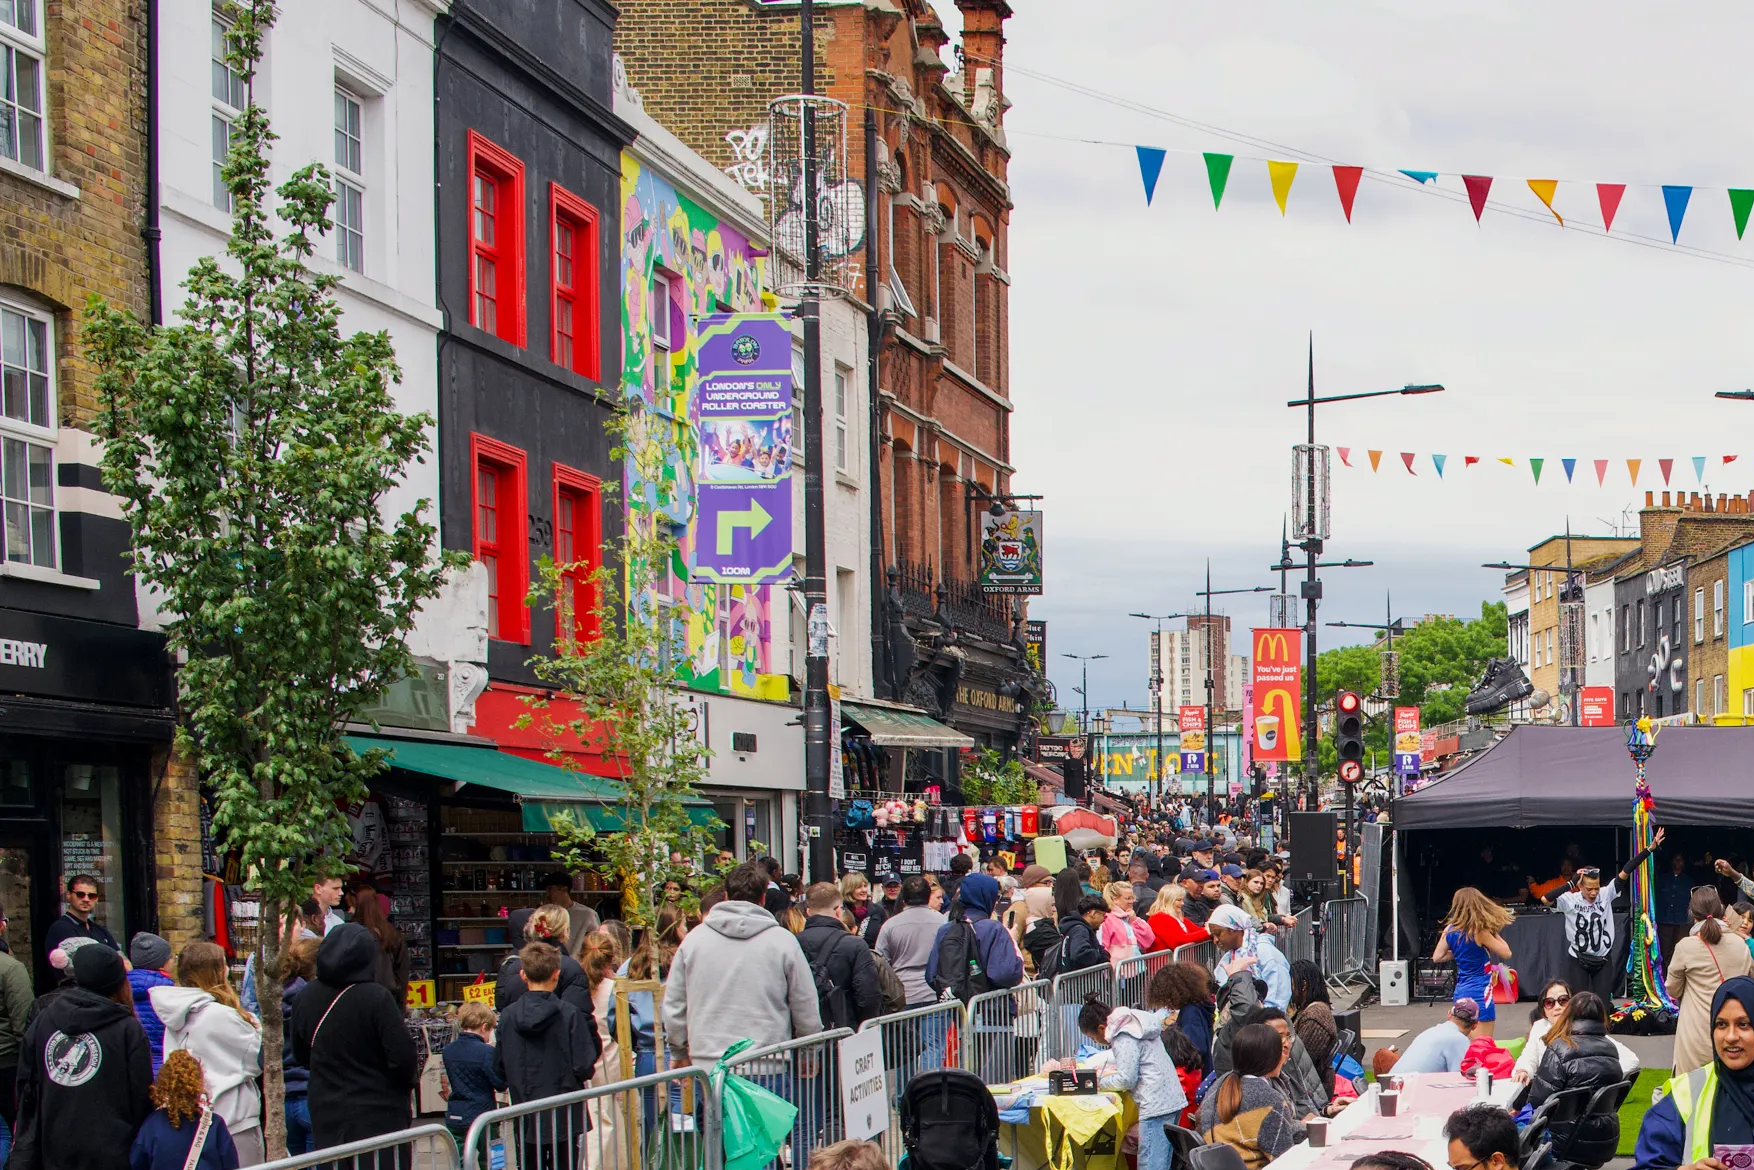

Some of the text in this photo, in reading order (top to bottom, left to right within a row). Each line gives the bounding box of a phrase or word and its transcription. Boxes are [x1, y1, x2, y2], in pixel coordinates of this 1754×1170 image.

[705, 381, 782, 391] LONDON'S ONLY
[705, 391, 780, 401] UNDERGROUND
[701, 401, 787, 411] ROLLER COASTER
[721, 566, 751, 575] 100M
[983, 585, 1040, 593] OXFORD ARMS
[0, 638, 47, 668] ERRY
[1281, 665, 1297, 675] just
[1256, 674, 1284, 683] passed
[955, 686, 1015, 713] THE OXFORD ARMS
[468, 987, 496, 999] £2 EAC
[855, 1052, 874, 1076] CRAFT
[850, 1073, 883, 1105] ACTIVITIES
